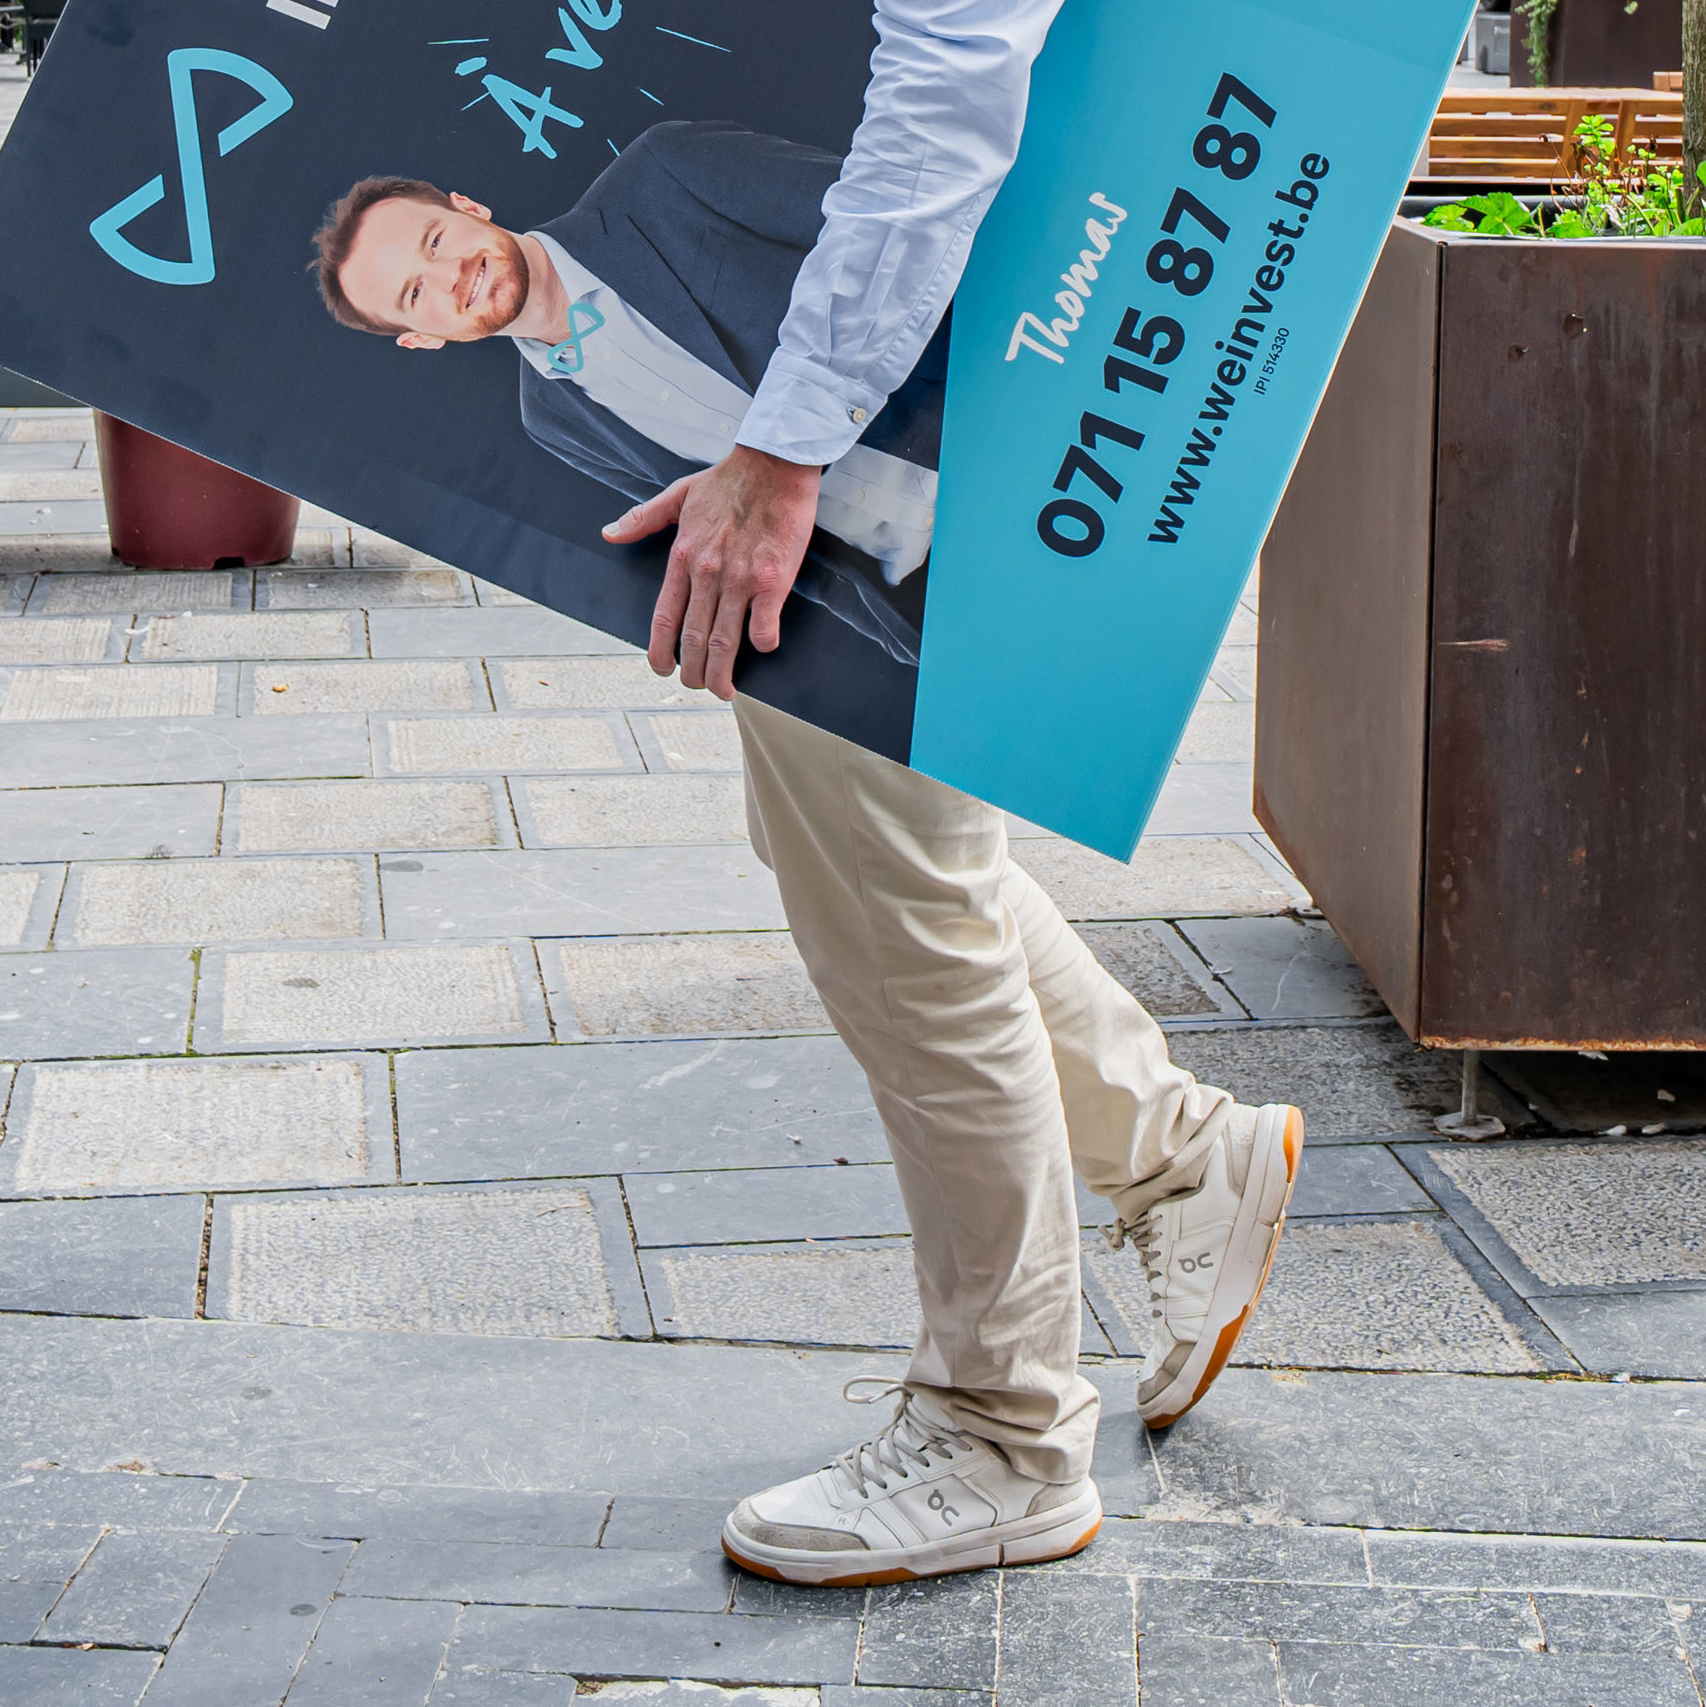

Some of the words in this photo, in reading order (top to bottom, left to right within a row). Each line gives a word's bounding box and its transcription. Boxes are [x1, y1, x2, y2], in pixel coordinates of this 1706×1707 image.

[455, 56, 584, 159] À
[1004, 191, 1128, 365] Thomas
[1036, 410, 1146, 558] 071
[1103, 306, 1186, 394] 15
[1145, 186, 1231, 297] 87
[1192, 72, 1277, 181] 87
[1147, 152, 1330, 544] www.weinvest.be
[1254, 375, 1271, 396] IPI
[1262, 327, 1290, 375] 514330
